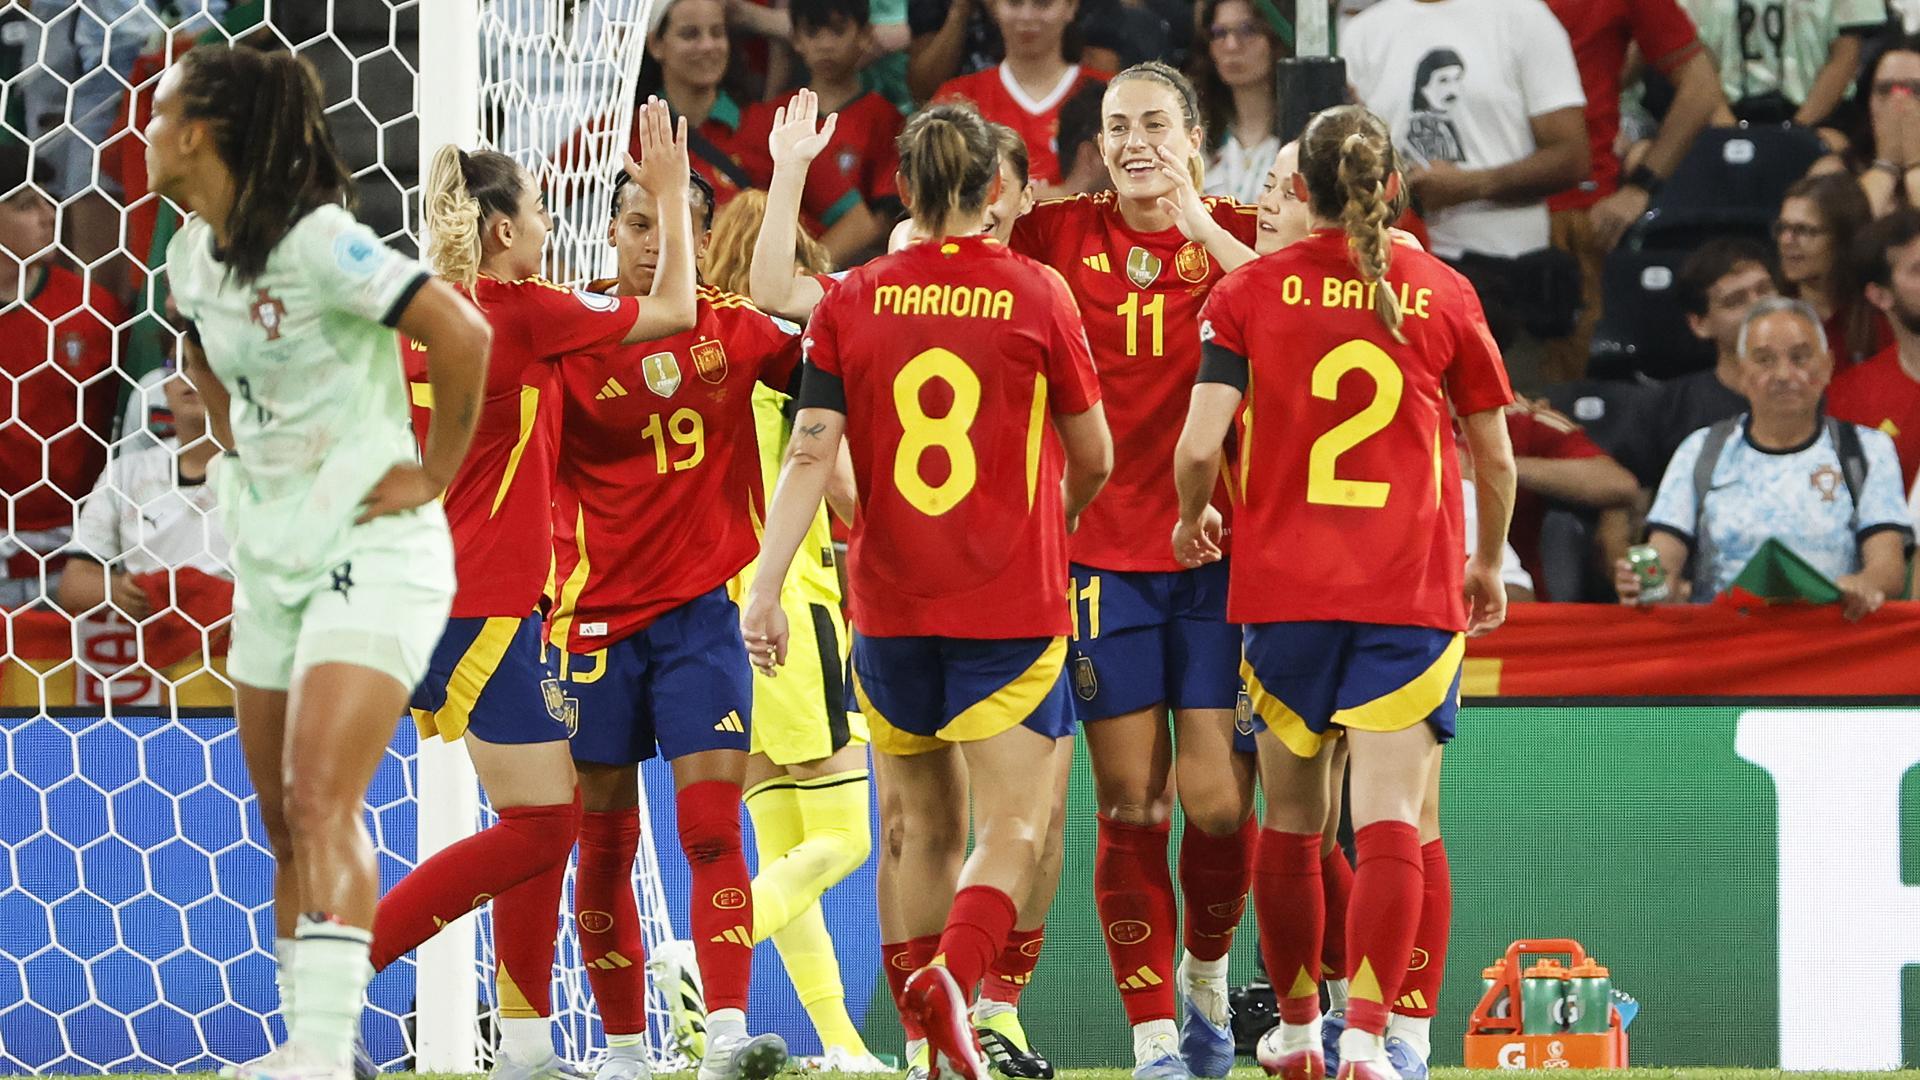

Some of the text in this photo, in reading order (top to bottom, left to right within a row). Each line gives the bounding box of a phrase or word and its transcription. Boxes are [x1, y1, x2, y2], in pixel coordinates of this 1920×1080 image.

[1738, 2, 1784, 59] 29
[873, 284, 1014, 320] MARIONA
[1116, 292, 1165, 356] 11
[1282, 275, 1433, 319] O. BATLE
[641, 407, 704, 474] 19
[893, 347, 981, 516] 8
[1307, 339, 1404, 507] 2
[1065, 575, 1100, 641] 11
[1498, 1042, 1526, 1069] G
